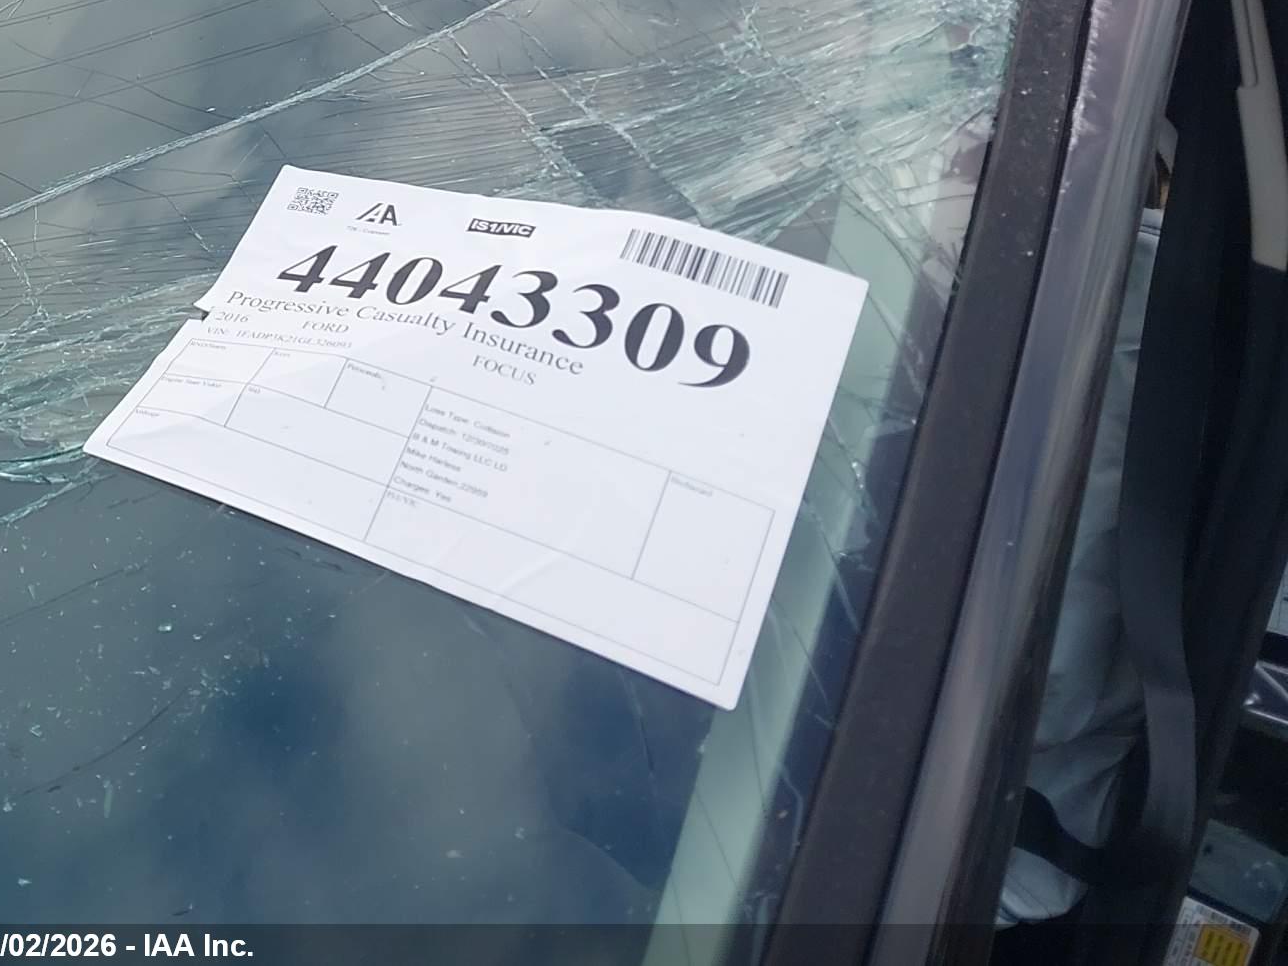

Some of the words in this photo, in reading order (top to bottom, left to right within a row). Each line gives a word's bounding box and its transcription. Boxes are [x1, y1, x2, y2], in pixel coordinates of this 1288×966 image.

[215, 310, 249, 324] 2016
[301, 320, 350, 334] FORD
[473, 354, 538, 385] FOCUS
[226, 290, 350, 318] Progressive
[355, 304, 457, 336] Casualty
[463, 321, 584, 377] Insurance
[277, 244, 751, 389] 44043309
